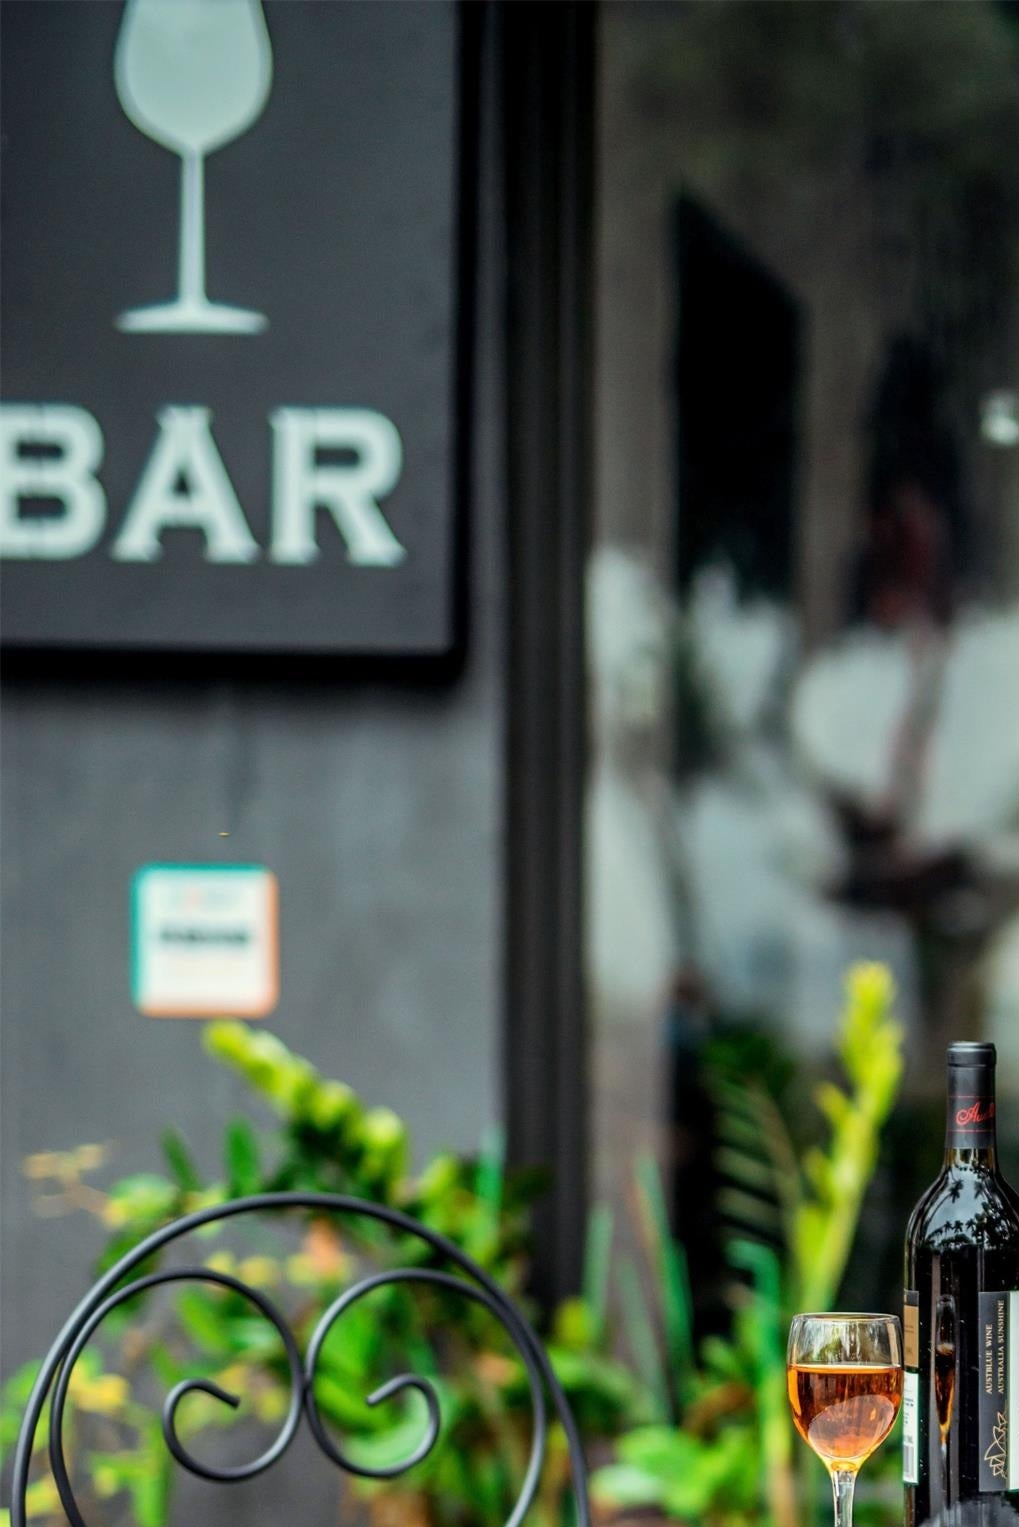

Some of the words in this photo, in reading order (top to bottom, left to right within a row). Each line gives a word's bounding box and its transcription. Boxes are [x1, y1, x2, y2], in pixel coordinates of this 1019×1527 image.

[0, 402, 406, 566] BAR
[985, 1324, 993, 1347] WINE
[985, 1350, 993, 1394] AUSTBLUE
